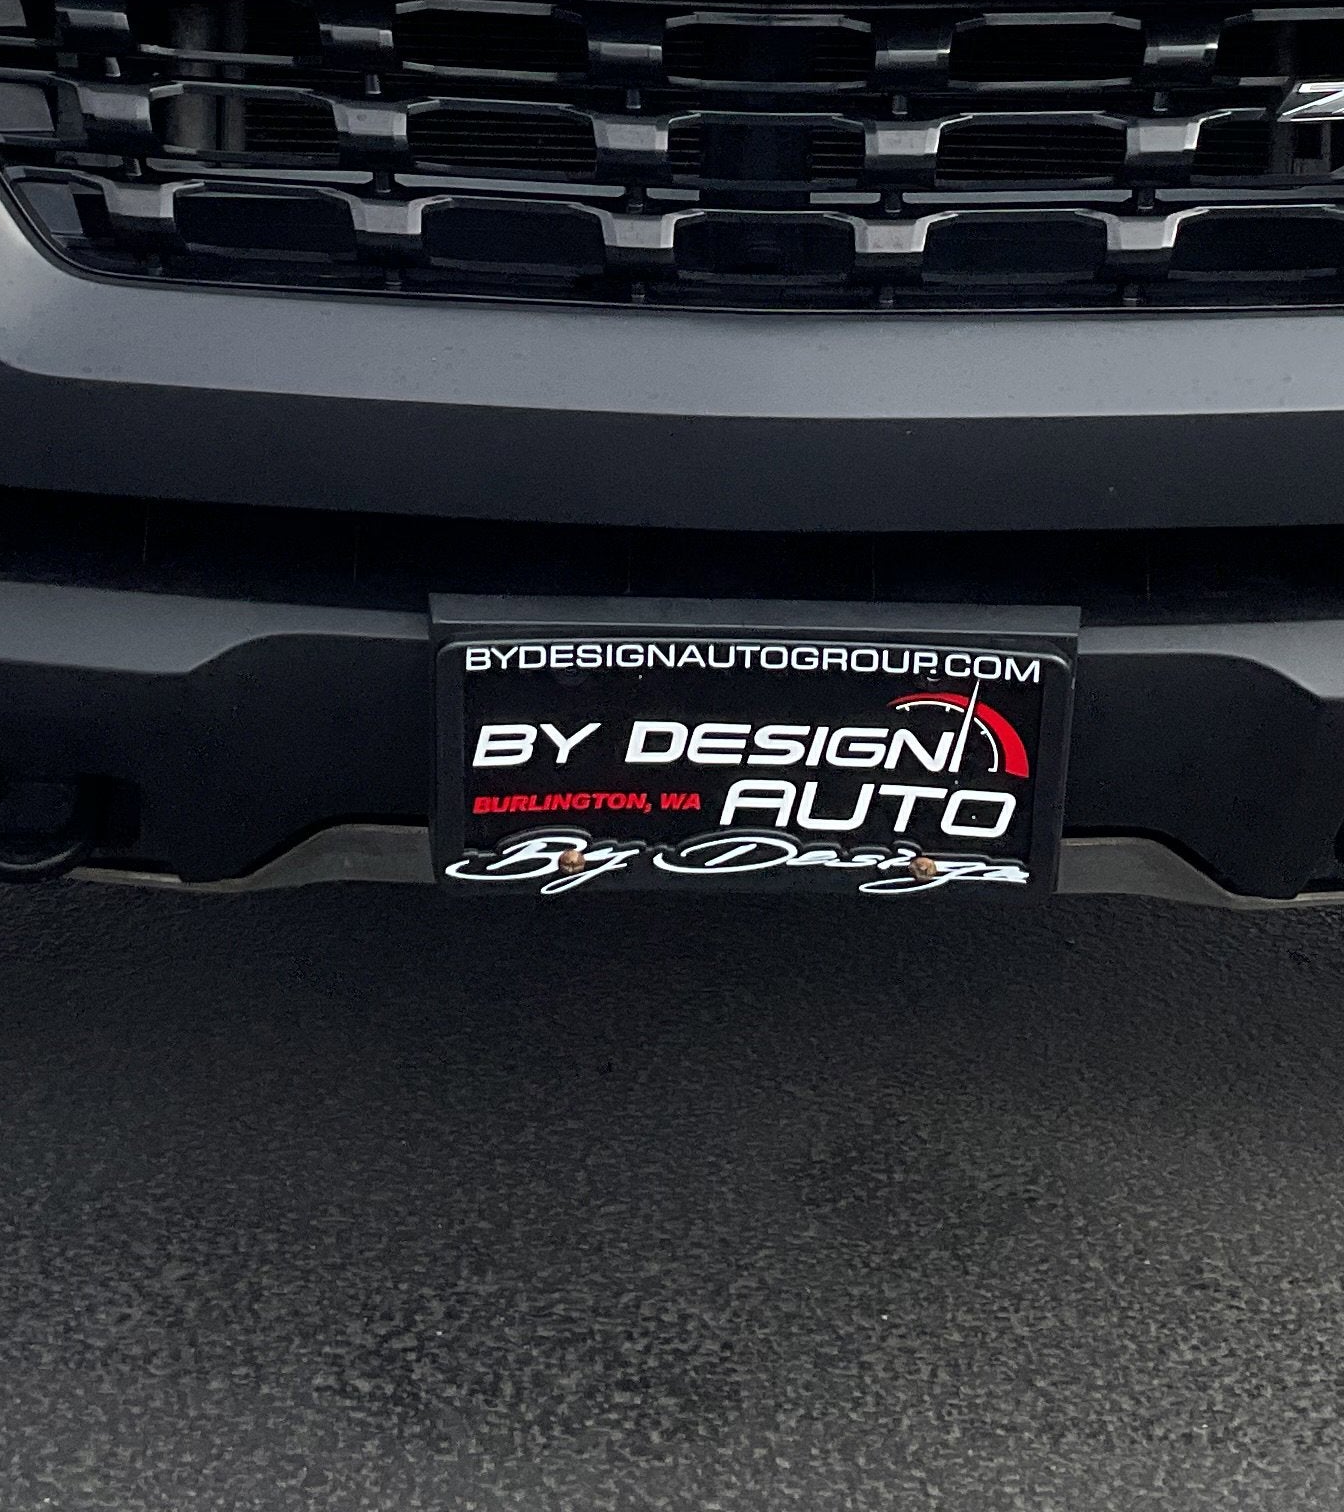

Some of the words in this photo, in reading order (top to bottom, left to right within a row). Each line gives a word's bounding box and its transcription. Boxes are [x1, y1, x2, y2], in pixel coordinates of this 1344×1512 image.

[465, 645, 1040, 683] BYDESIGNAUTOGROUP.COM
[472, 722, 601, 767] BY
[624, 721, 955, 772] DESIGN
[472, 793, 652, 814] BURLINGTON,
[659, 793, 701, 811] WA
[719, 779, 1017, 838] AUTO
